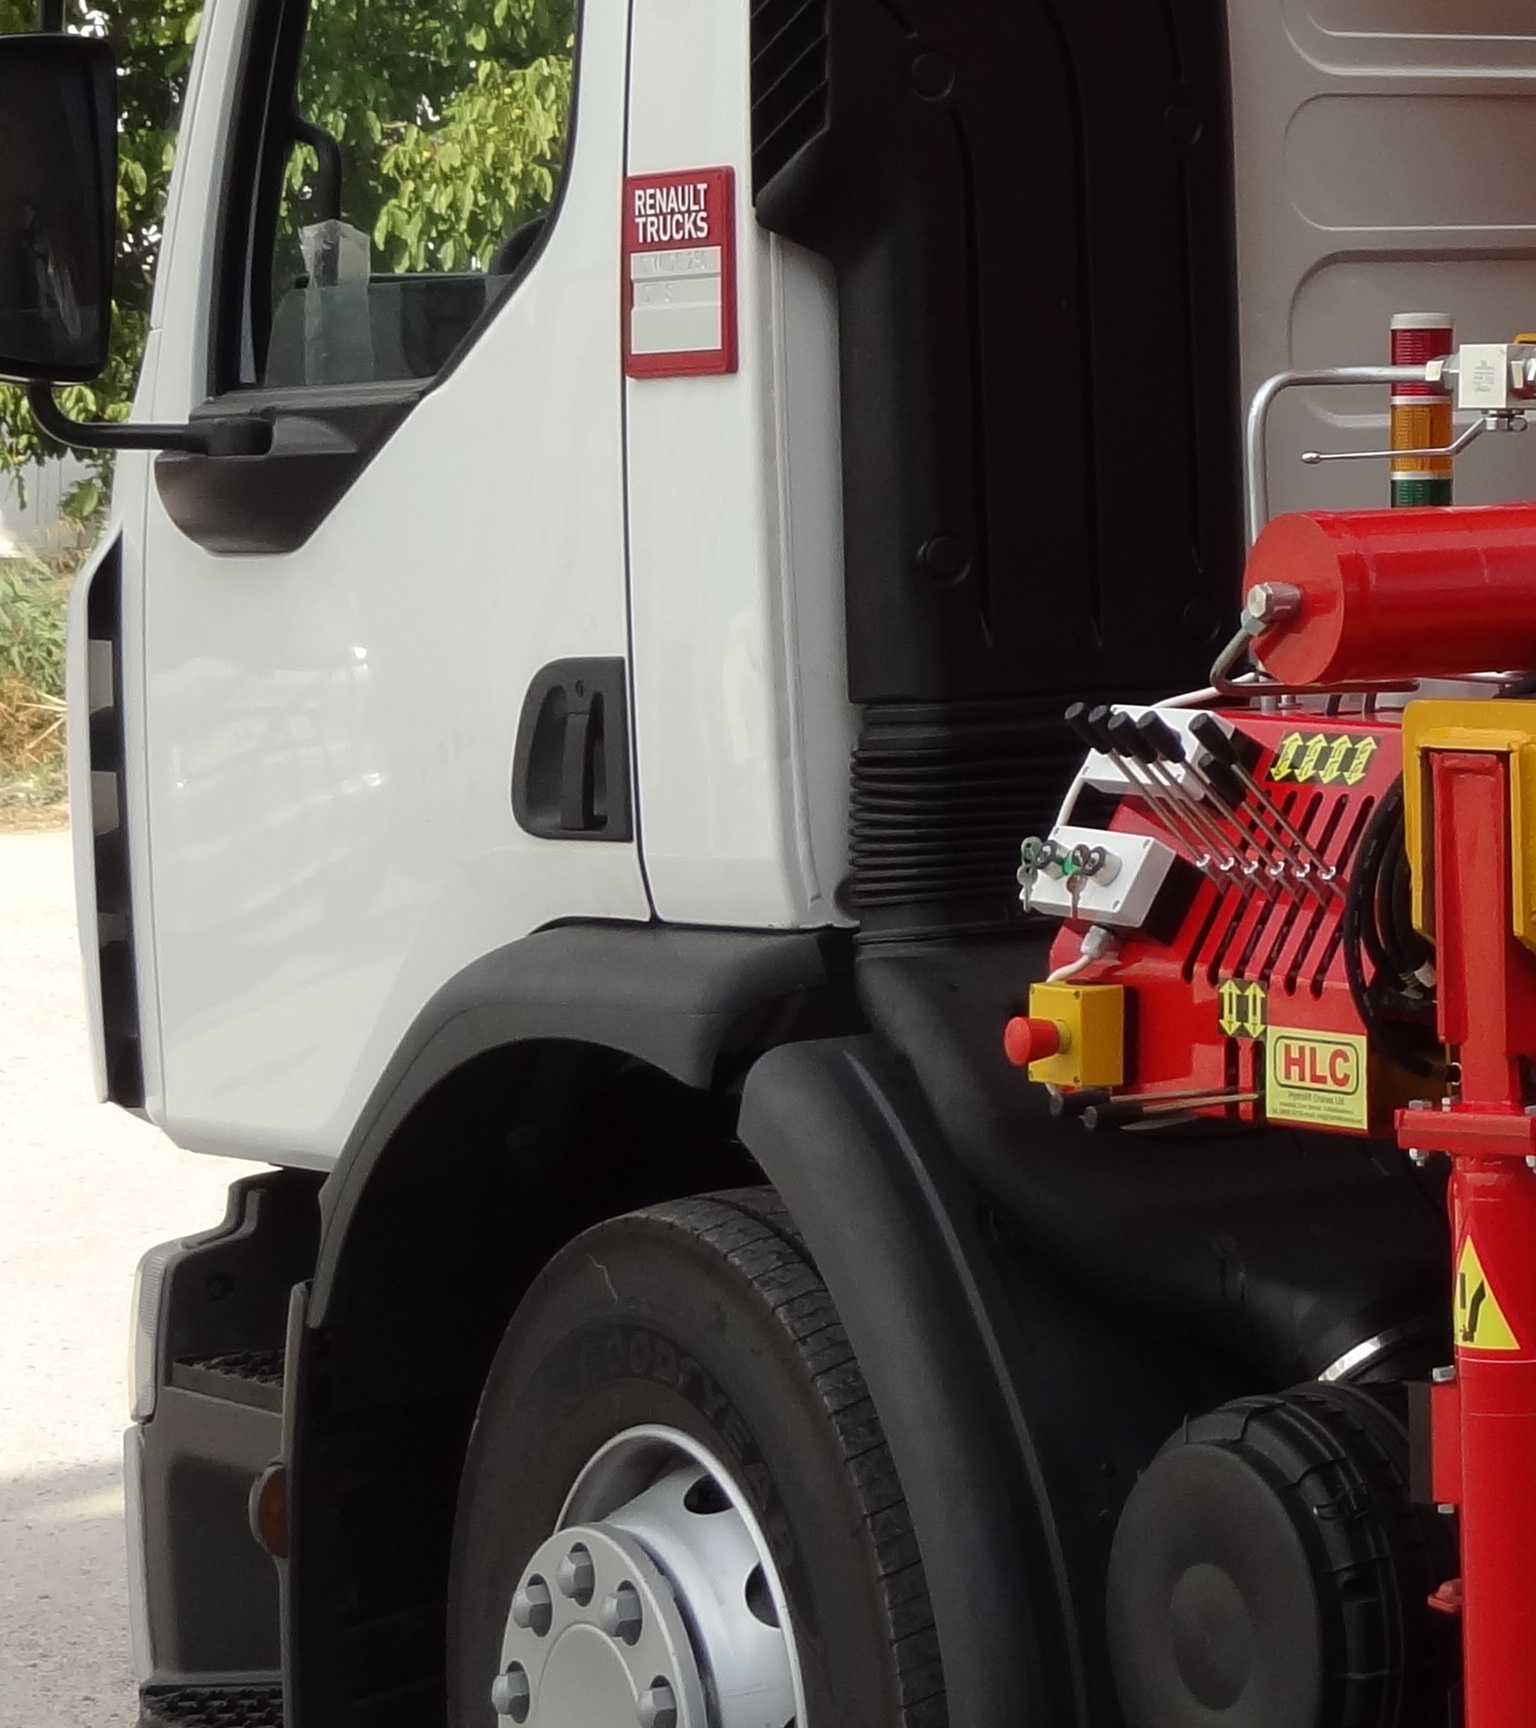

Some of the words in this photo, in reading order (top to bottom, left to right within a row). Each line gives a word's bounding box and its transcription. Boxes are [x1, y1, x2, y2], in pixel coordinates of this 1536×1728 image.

[634, 183, 708, 216] RENAULT
[634, 212, 709, 243] TRUCKS
[1283, 1043, 1351, 1087] HLC
